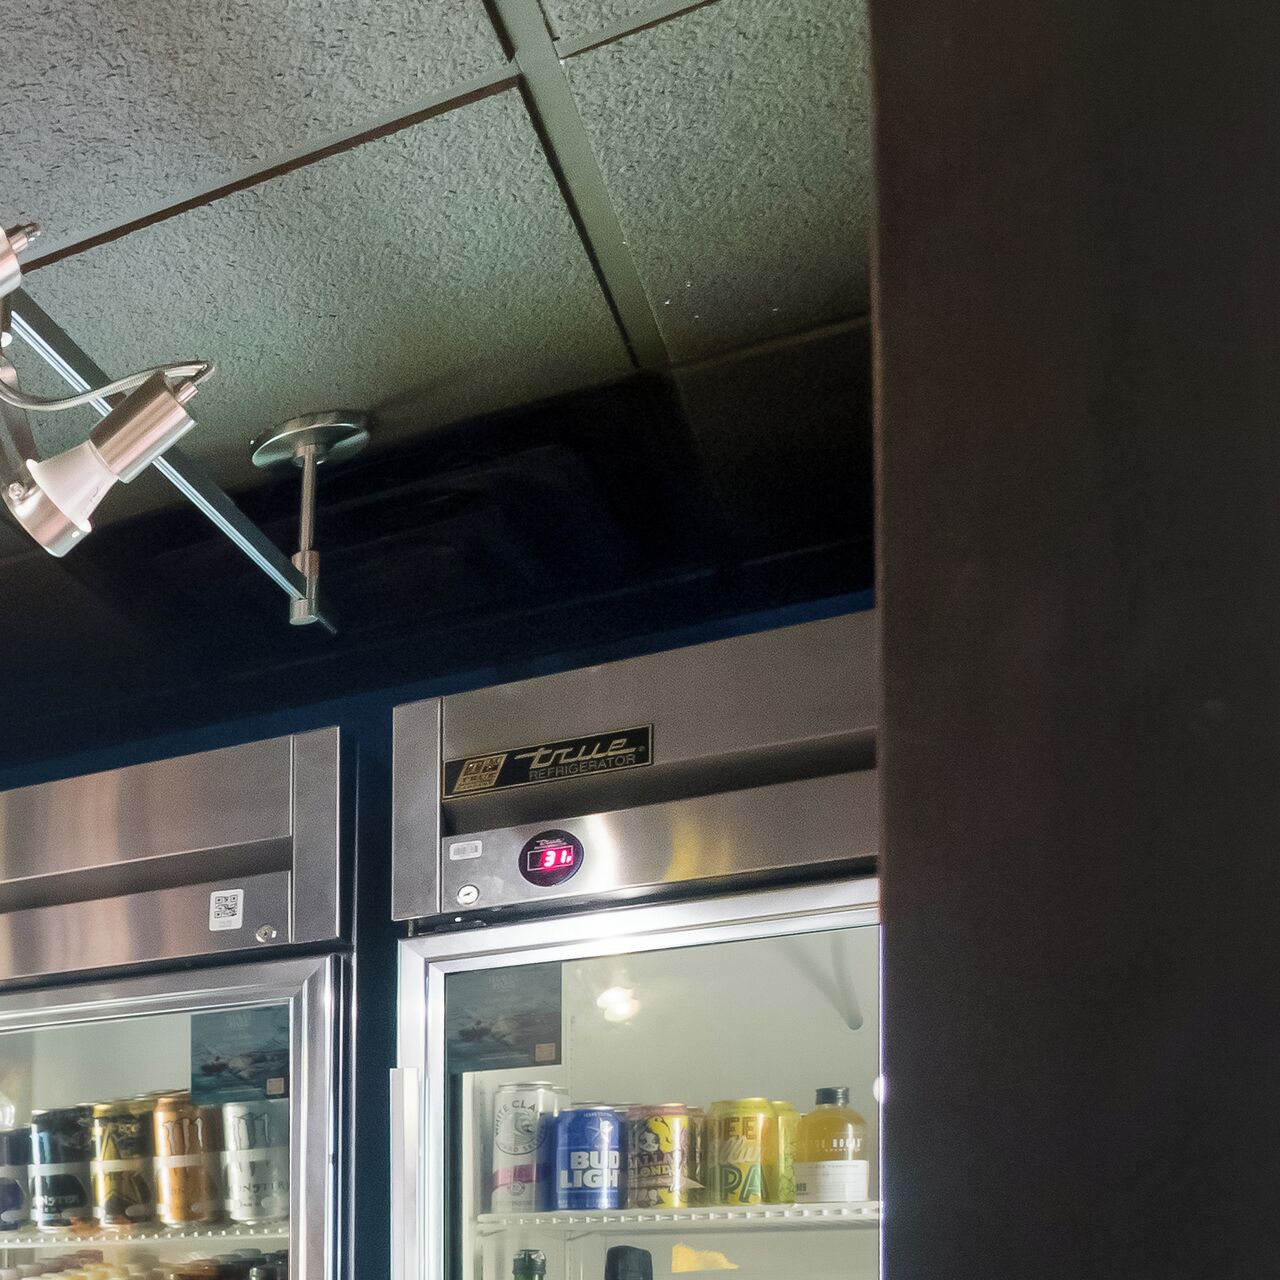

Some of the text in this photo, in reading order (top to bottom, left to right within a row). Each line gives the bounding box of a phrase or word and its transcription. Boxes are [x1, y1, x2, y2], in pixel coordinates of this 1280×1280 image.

[514, 738, 638, 769] true
[529, 754, 637, 781] REFRIGERATOR
[570, 1151, 620, 1169] BUD
